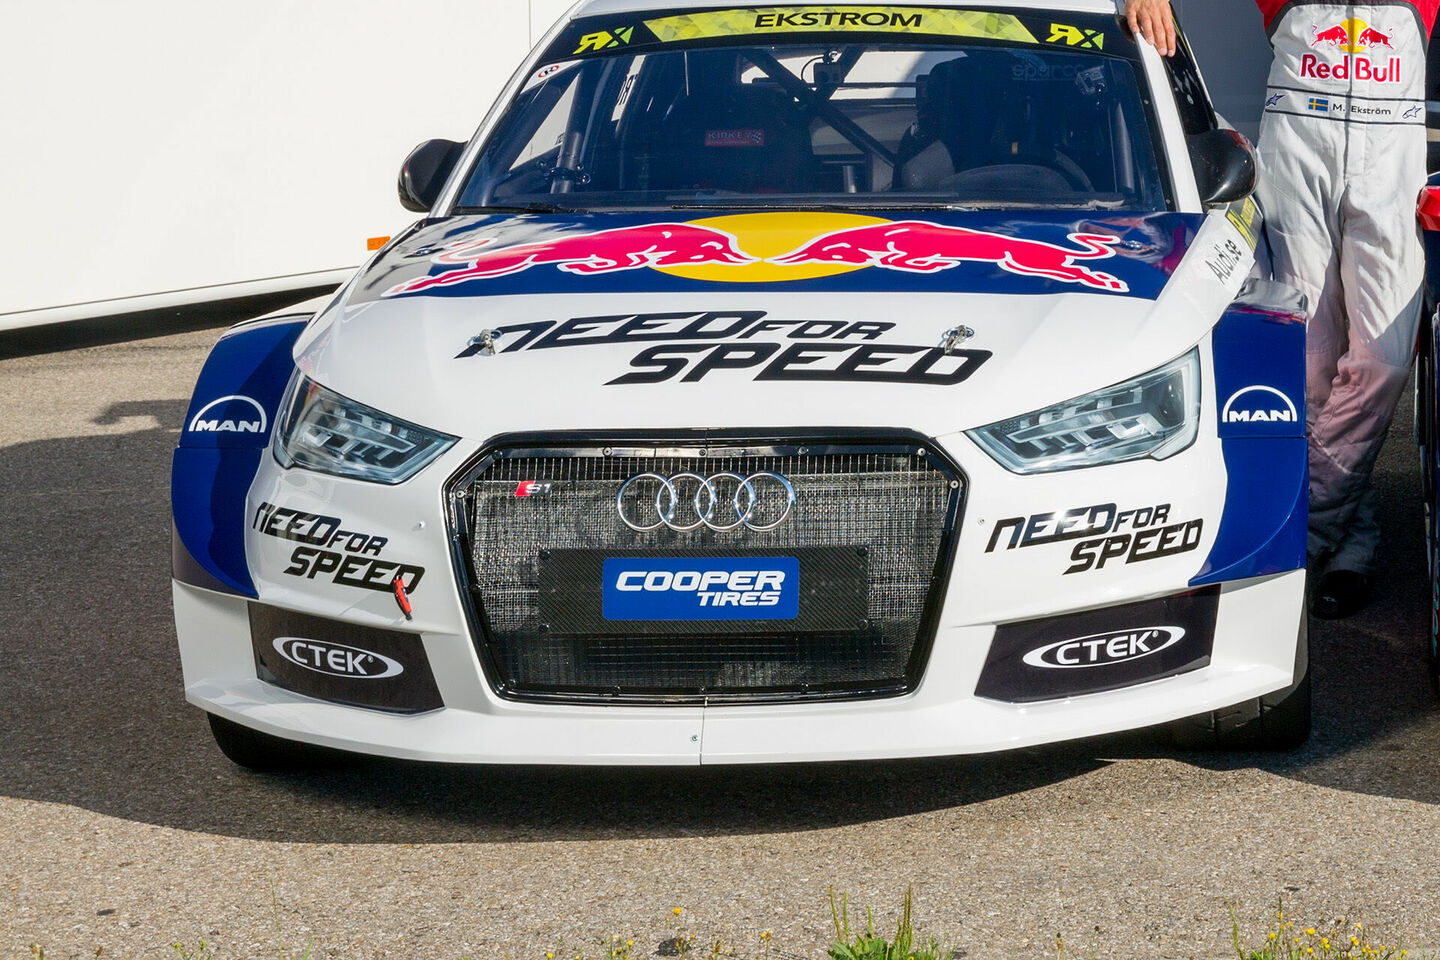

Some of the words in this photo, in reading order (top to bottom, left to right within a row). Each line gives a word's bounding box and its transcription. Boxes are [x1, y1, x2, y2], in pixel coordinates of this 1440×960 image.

[754, 12, 922, 28] EKSTROM
[1300, 54, 1350, 80] Red
[1352, 56, 1401, 83] Bull
[1332, 104, 1346, 112] M.
[1351, 106, 1391, 116] Ekström
[454, 311, 768, 359] NEED
[735, 320, 897, 340] FOR
[602, 343, 993, 386] SPEED
[195, 419, 260, 433] MAN
[1229, 410, 1292, 423] MAN
[252, 501, 342, 545] NEED
[331, 530, 388, 556] FOR
[984, 503, 1118, 553] NEED
[1112, 503, 1171, 534] FOR
[1062, 518, 1204, 575] SPEED
[283, 546, 425, 594] SPEED
[616, 570, 786, 592] COOPER
[697, 591, 780, 607] TIRES
[291, 641, 369, 675] CTEK
[1056, 631, 1153, 665] CTEK
